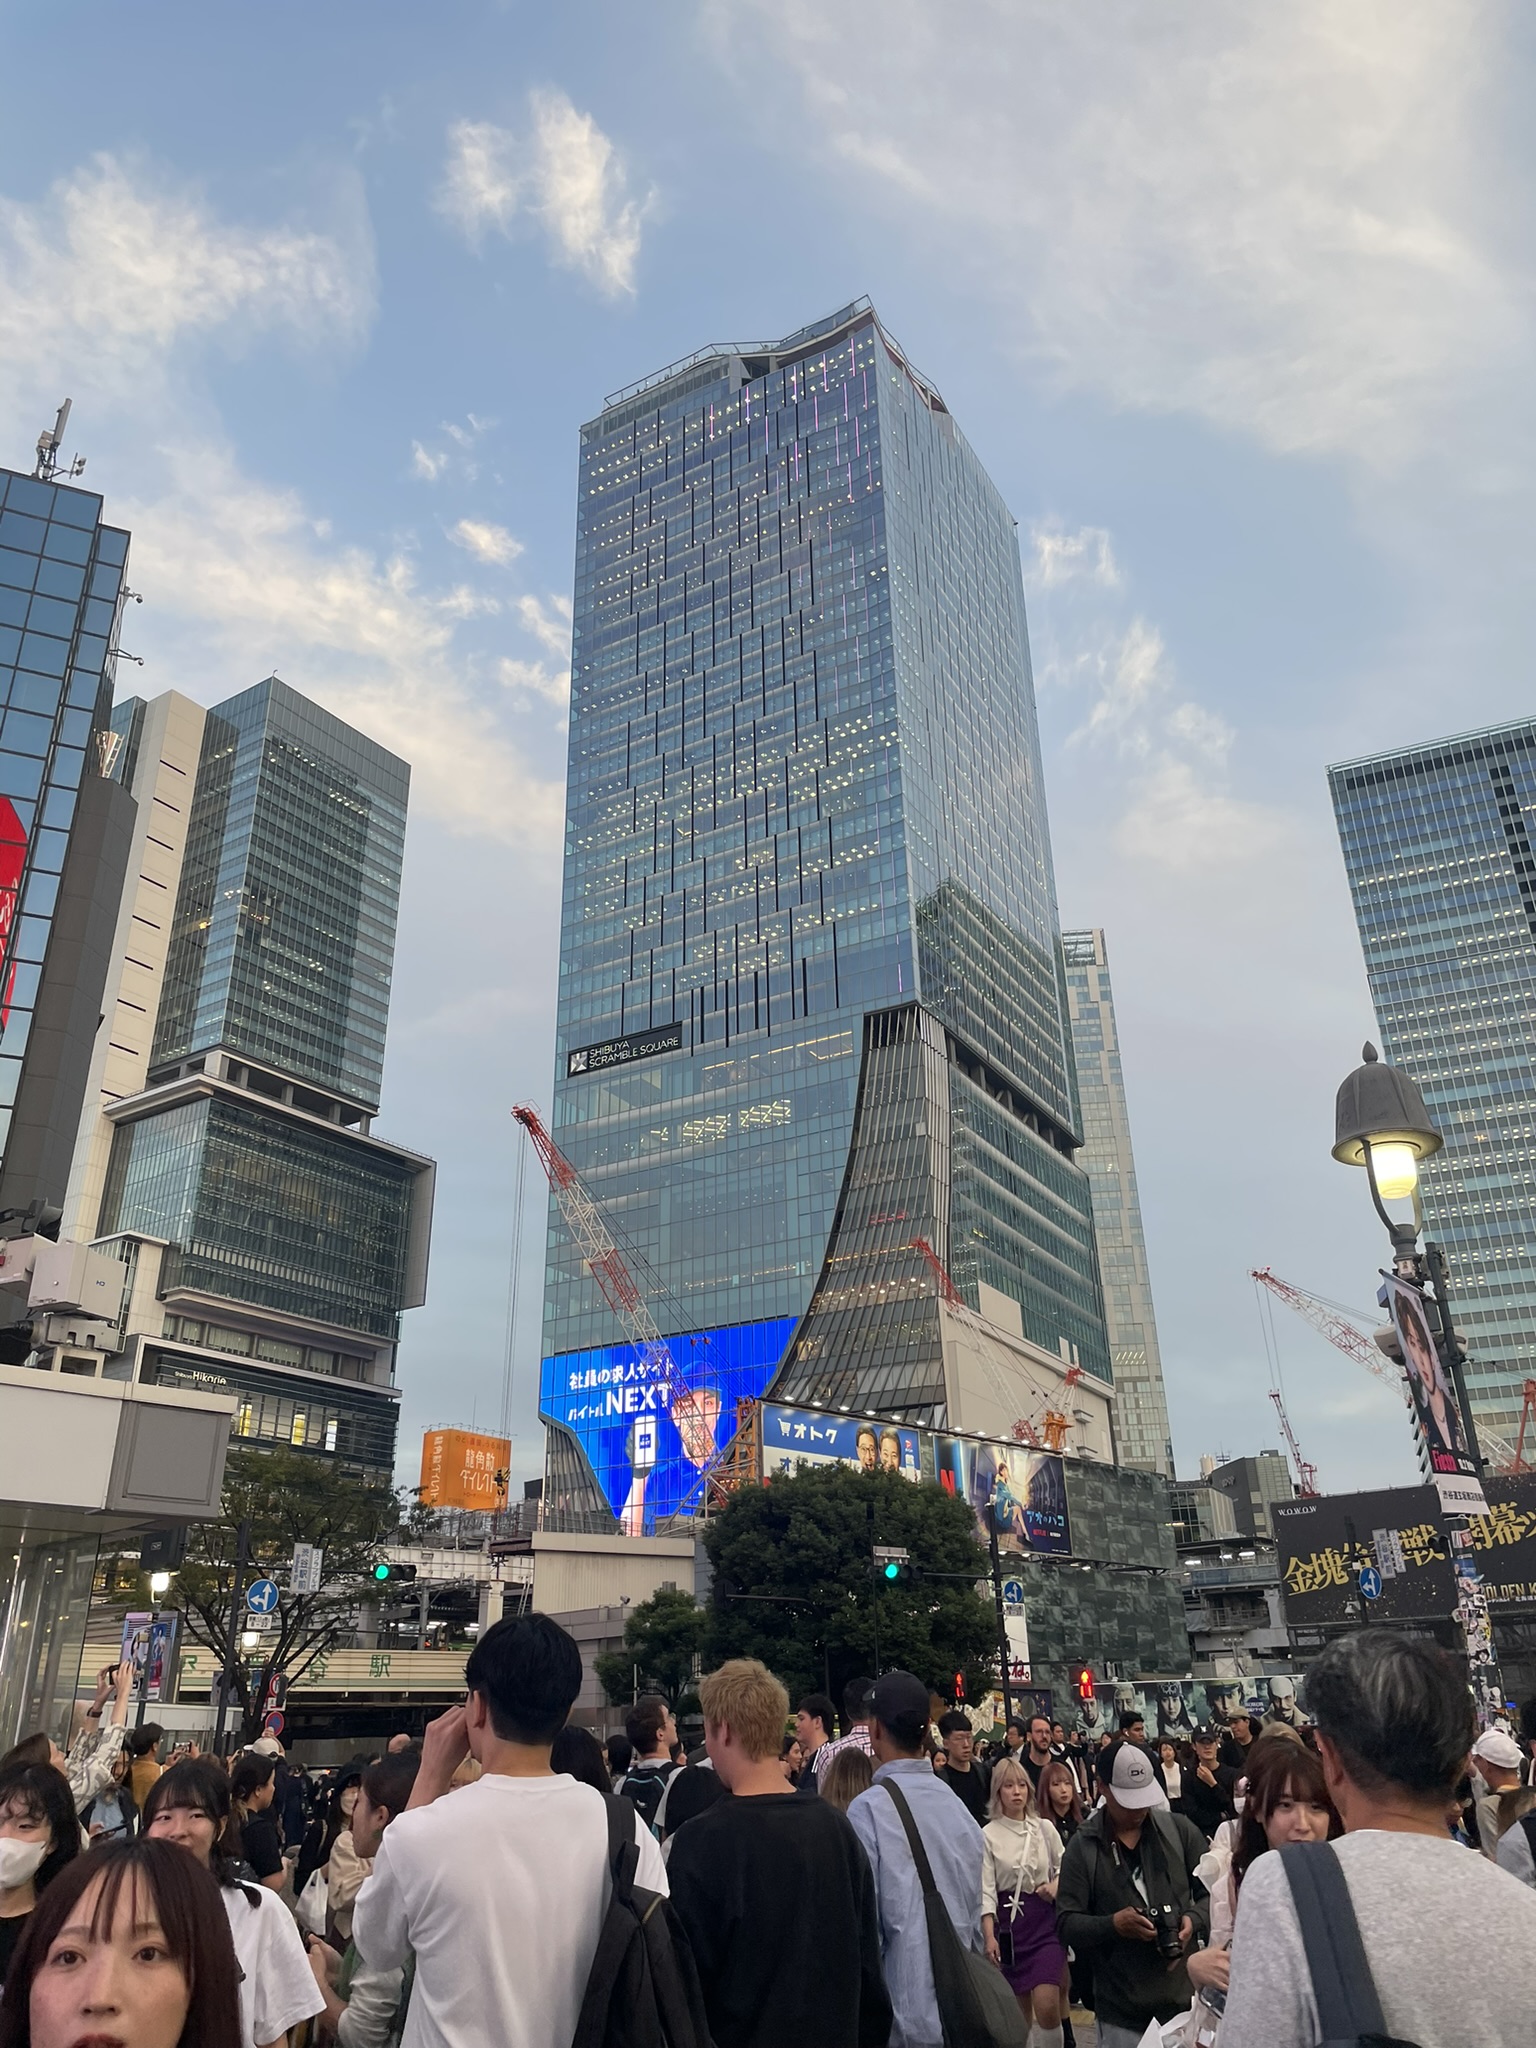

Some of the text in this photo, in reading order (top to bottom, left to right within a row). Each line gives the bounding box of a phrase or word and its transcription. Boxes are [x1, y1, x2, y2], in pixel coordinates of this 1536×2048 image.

[589, 1036, 679, 1068] SCRAMBLE SQUARE
[590, 1040, 630, 1058] SHIBUYA
[193, 1370, 227, 1385] Hikarie
[569, 1358, 674, 1390] 社員の求人サイト
[568, 1383, 673, 1421] バイトル NEXT
[793, 1423, 838, 1444] オトク
[460, 1469, 498, 1493] ダイレクト
[1278, 1504, 1317, 1516] WOWOW
[1484, 1584, 1525, 1600] OLDEN
